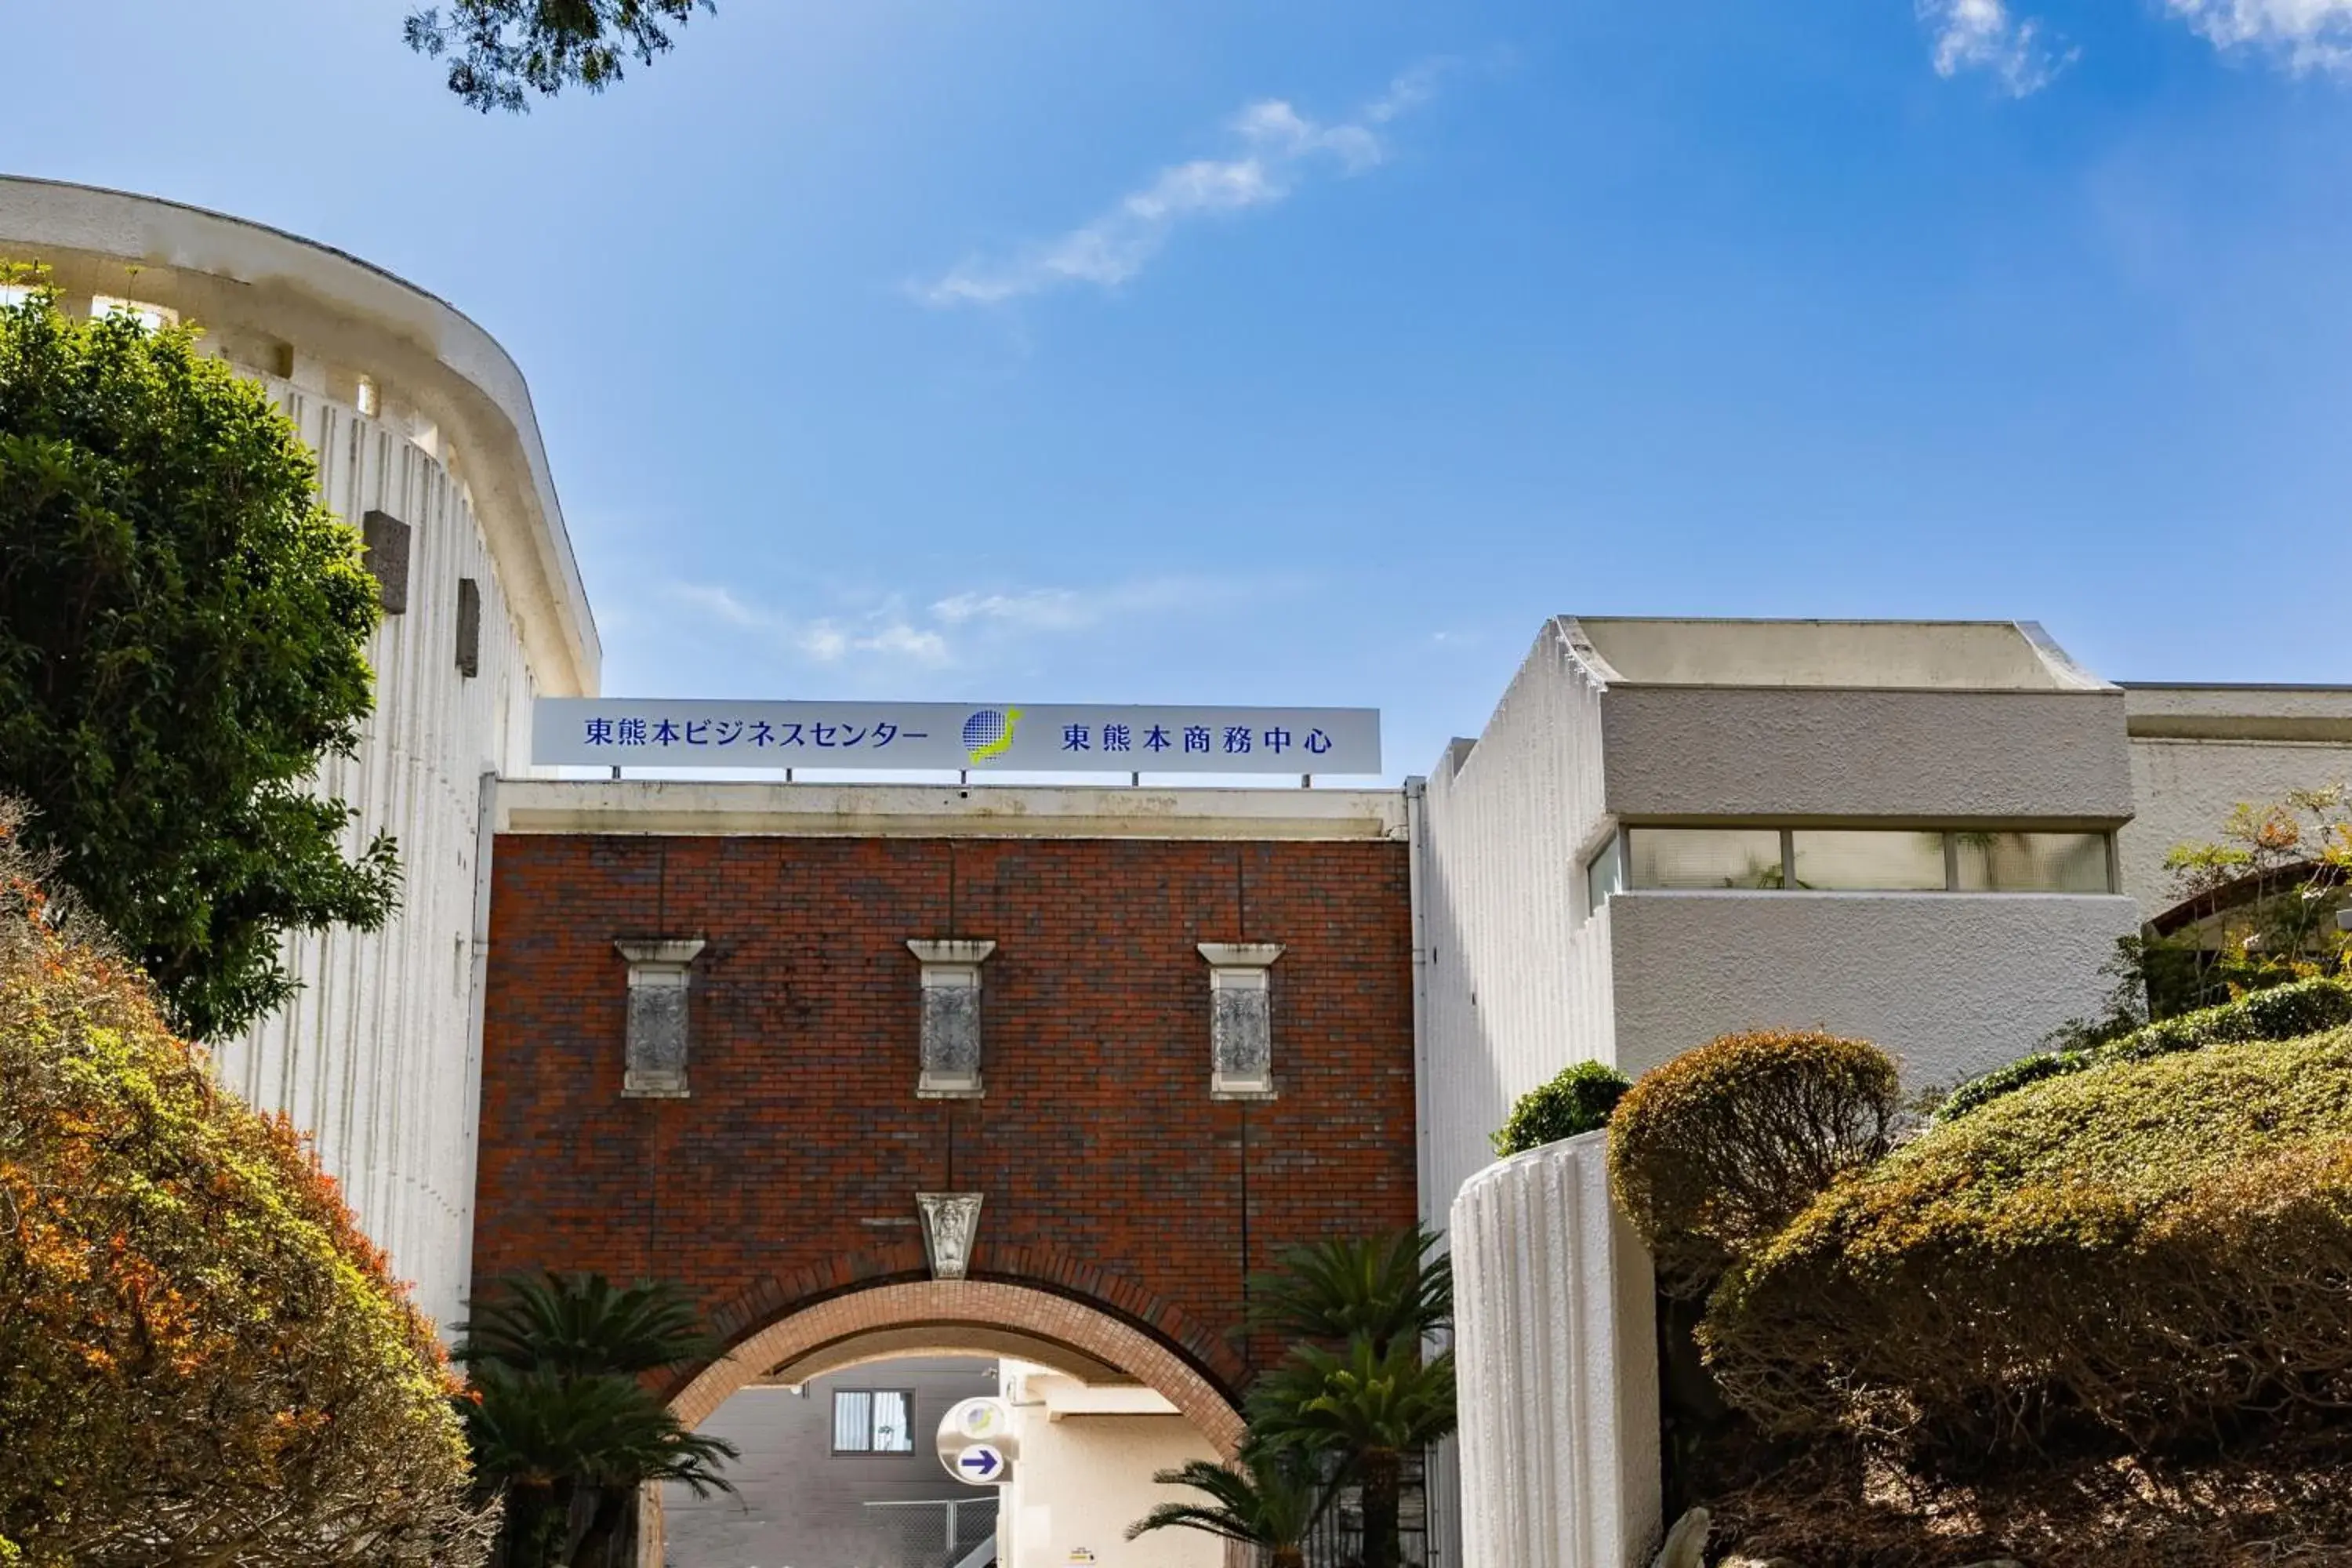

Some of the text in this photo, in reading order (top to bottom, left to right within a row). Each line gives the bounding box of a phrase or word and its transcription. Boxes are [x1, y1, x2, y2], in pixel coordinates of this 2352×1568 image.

[583, 717, 928, 749] 東熊本ビジネスセンター
[1062, 723, 1332, 754] 東熊本商務中心
